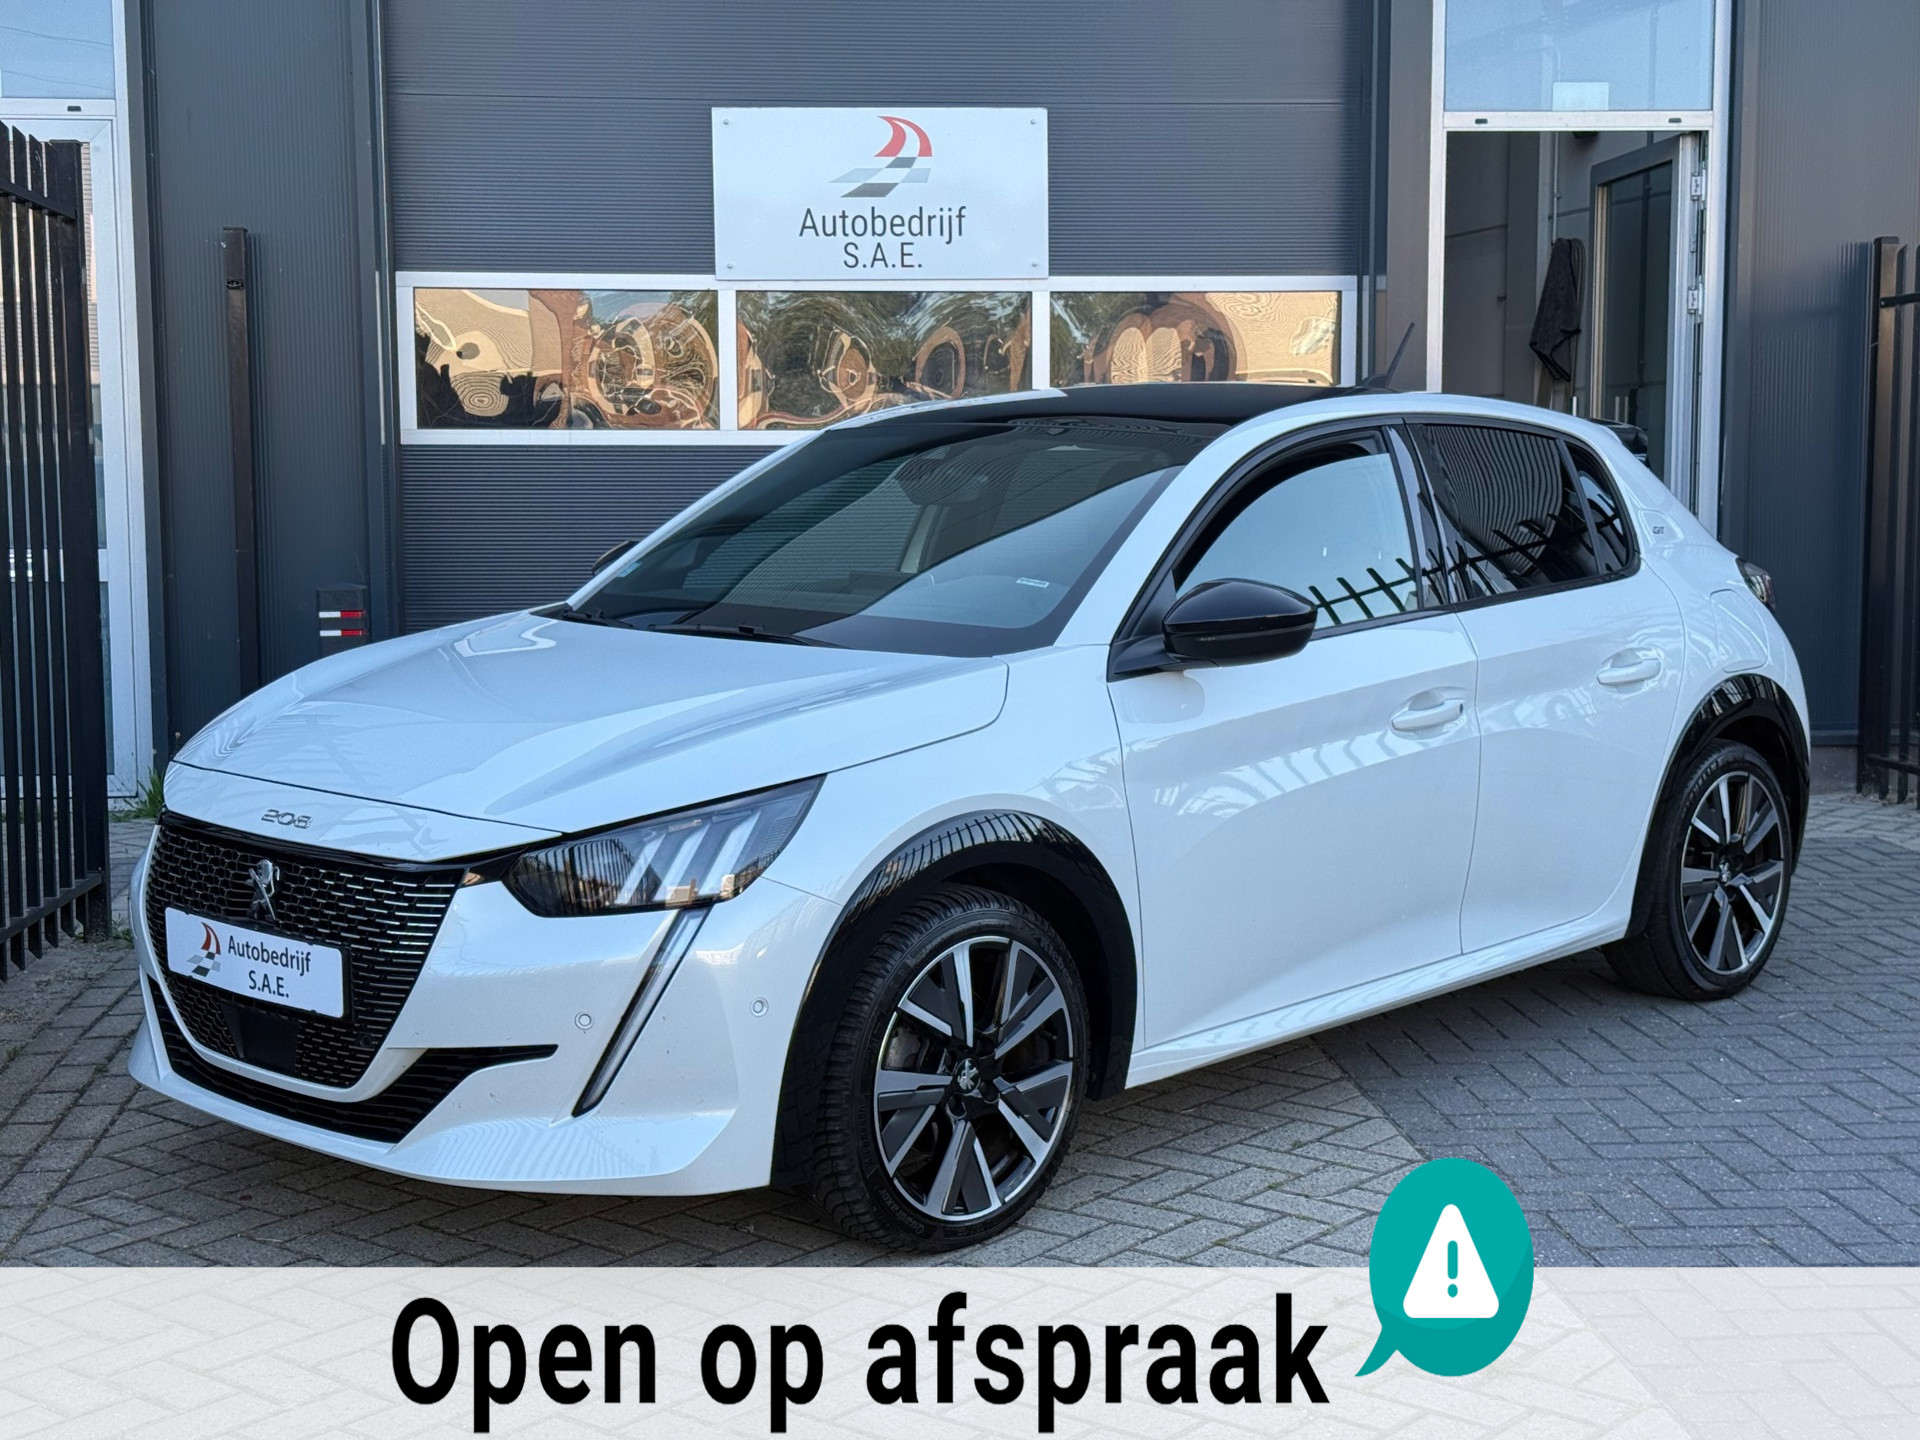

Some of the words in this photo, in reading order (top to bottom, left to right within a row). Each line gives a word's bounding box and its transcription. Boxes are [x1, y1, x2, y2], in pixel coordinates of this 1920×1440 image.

[799, 206, 966, 244] Autobedrijf
[843, 242, 923, 268] S.A.E.
[228, 935, 311, 977] Autobedrijf
[248, 969, 290, 998] S.A.E.
